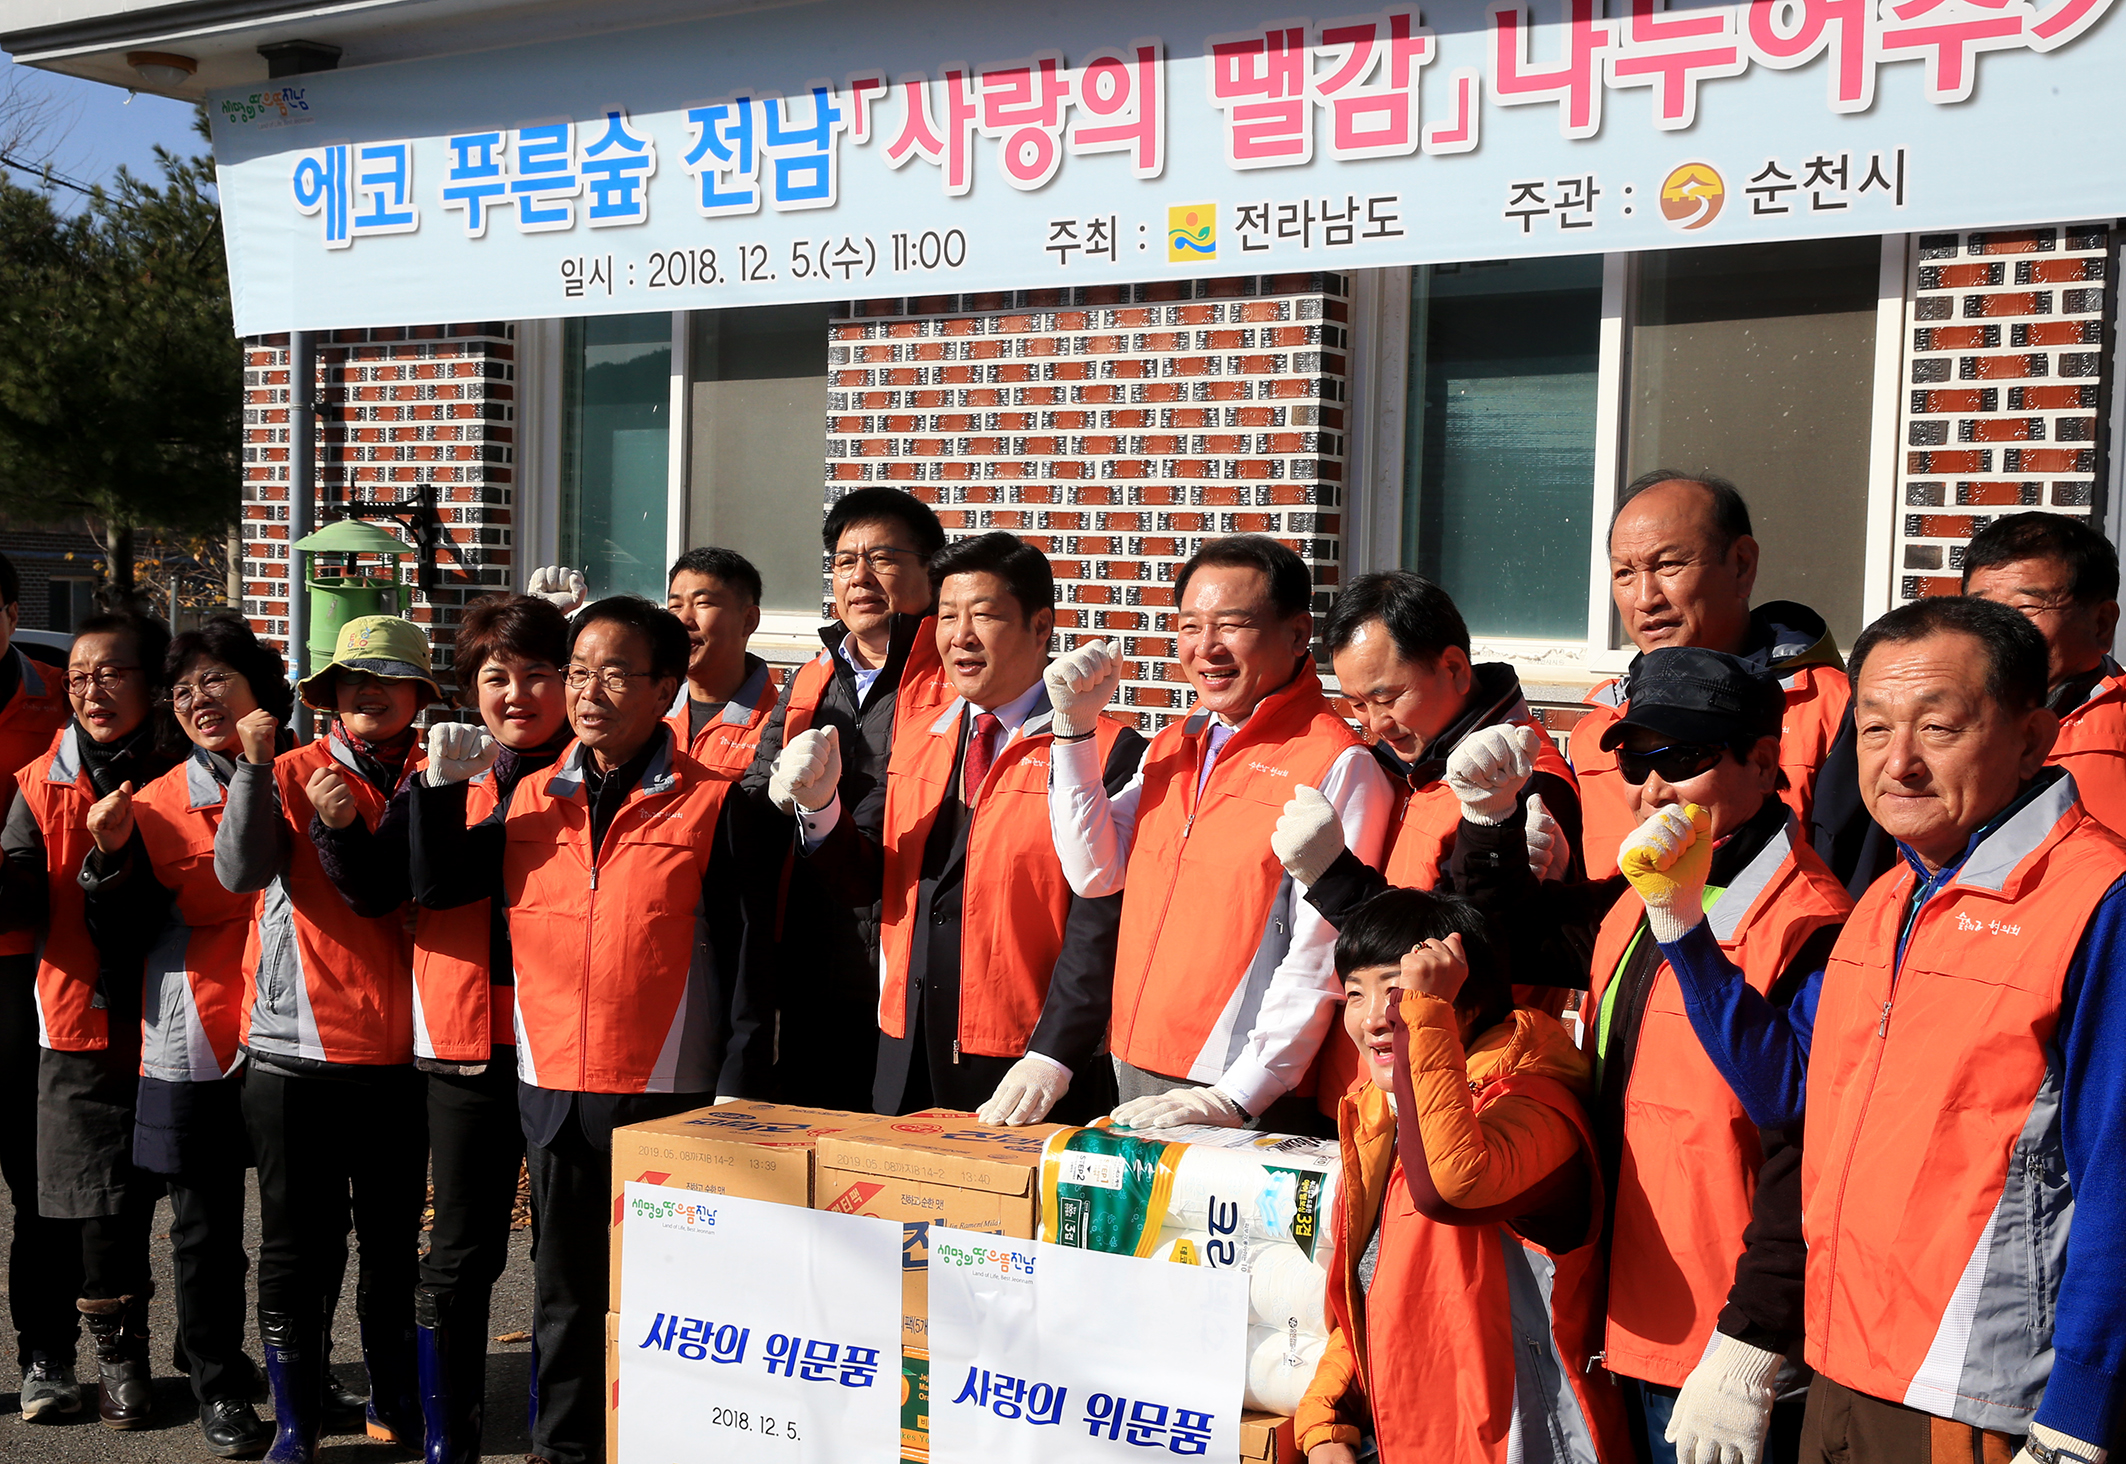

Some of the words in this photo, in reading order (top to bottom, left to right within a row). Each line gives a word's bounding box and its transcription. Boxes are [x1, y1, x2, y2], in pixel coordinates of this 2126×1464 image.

[292, 144, 413, 241] 에코
[442, 112, 651, 229] 푸른숲
[1504, 176, 1600, 233] 주관
[1745, 149, 1906, 215] 순천시
[561, 256, 612, 298] 일시
[649, 250, 724, 288] 2018.
[740, 246, 776, 282] 12.
[792, 236, 875, 280] 5.(수)
[893, 229, 966, 272] 11:00
[1045, 215, 1118, 265] 주최
[1234, 195, 1405, 252] 전라남도
[749, 1159, 777, 1171] 13:39
[961, 1171, 991, 1185] 13:40
[696, 1227, 715, 1235] Jeonnam
[972, 1270, 985, 1278] Land
[1000, 1274, 1010, 1282] Best
[1011, 1276, 1033, 1285] Jeonnam
[638, 1312, 750, 1364] 사랑의
[762, 1333, 880, 1388] 위문품
[712, 1406, 753, 1432] 2018.
[760, 1416, 779, 1437] 12.
[786, 1422, 801, 1441] 5.
[951, 1366, 1068, 1427] 사랑의
[1082, 1392, 1215, 1456] 위문품
